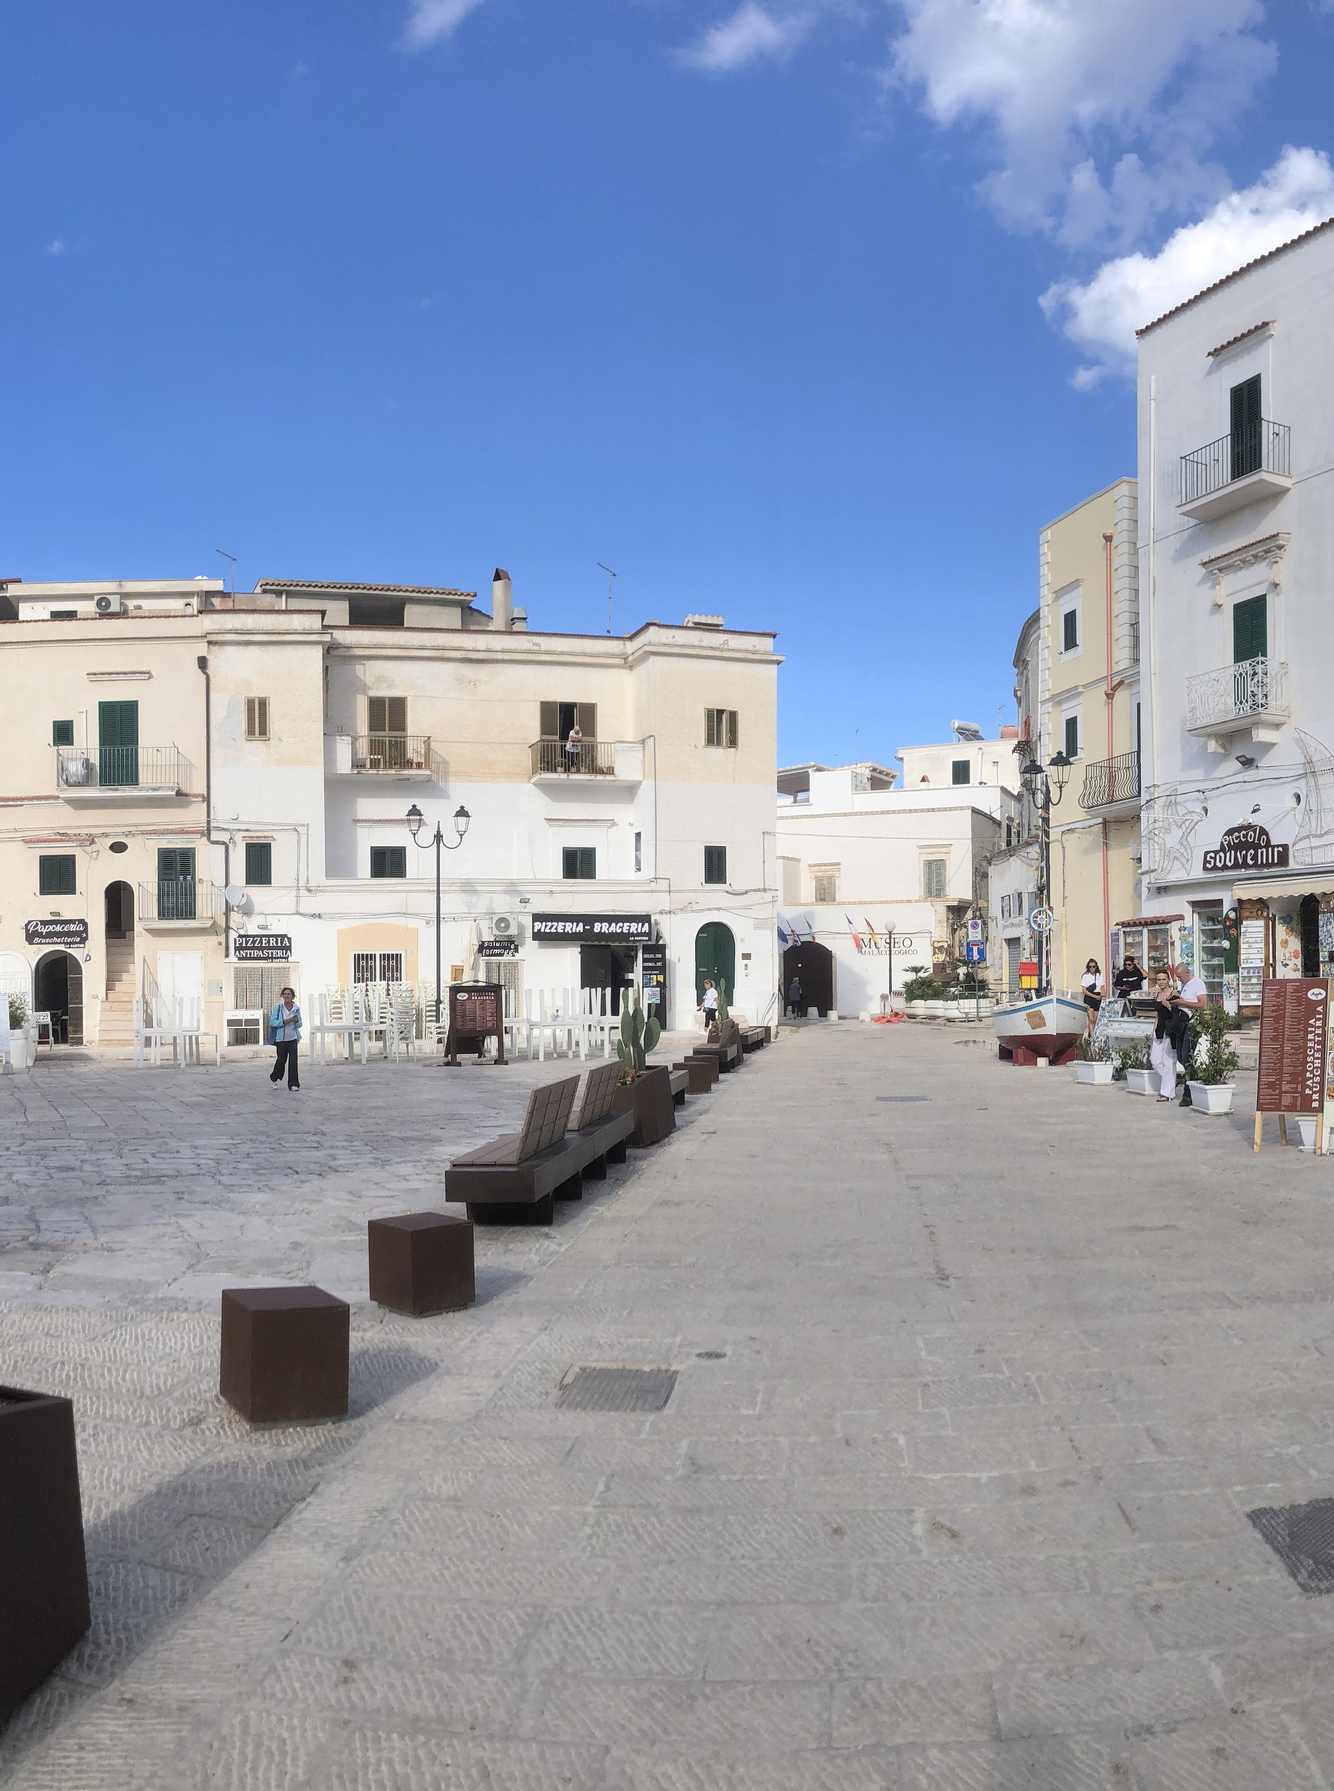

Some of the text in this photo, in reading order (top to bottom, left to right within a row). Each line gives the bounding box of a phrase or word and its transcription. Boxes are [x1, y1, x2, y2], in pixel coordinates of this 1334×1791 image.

[27, 920, 86, 936] Paposceria
[533, 921, 584, 934] PIZZERIA
[593, 922, 649, 934] BRACERIA
[33, 936, 81, 944] Bruschetteria
[235, 936, 290, 947] PIZZERIA
[860, 937, 913, 950] MUSEO
[234, 949, 292, 958] ANTIPASTERIA
[1305, 1017, 1316, 1095] PAPOSCERIA
[1311, 1004, 1324, 1108] BRUSCHETTERIA
